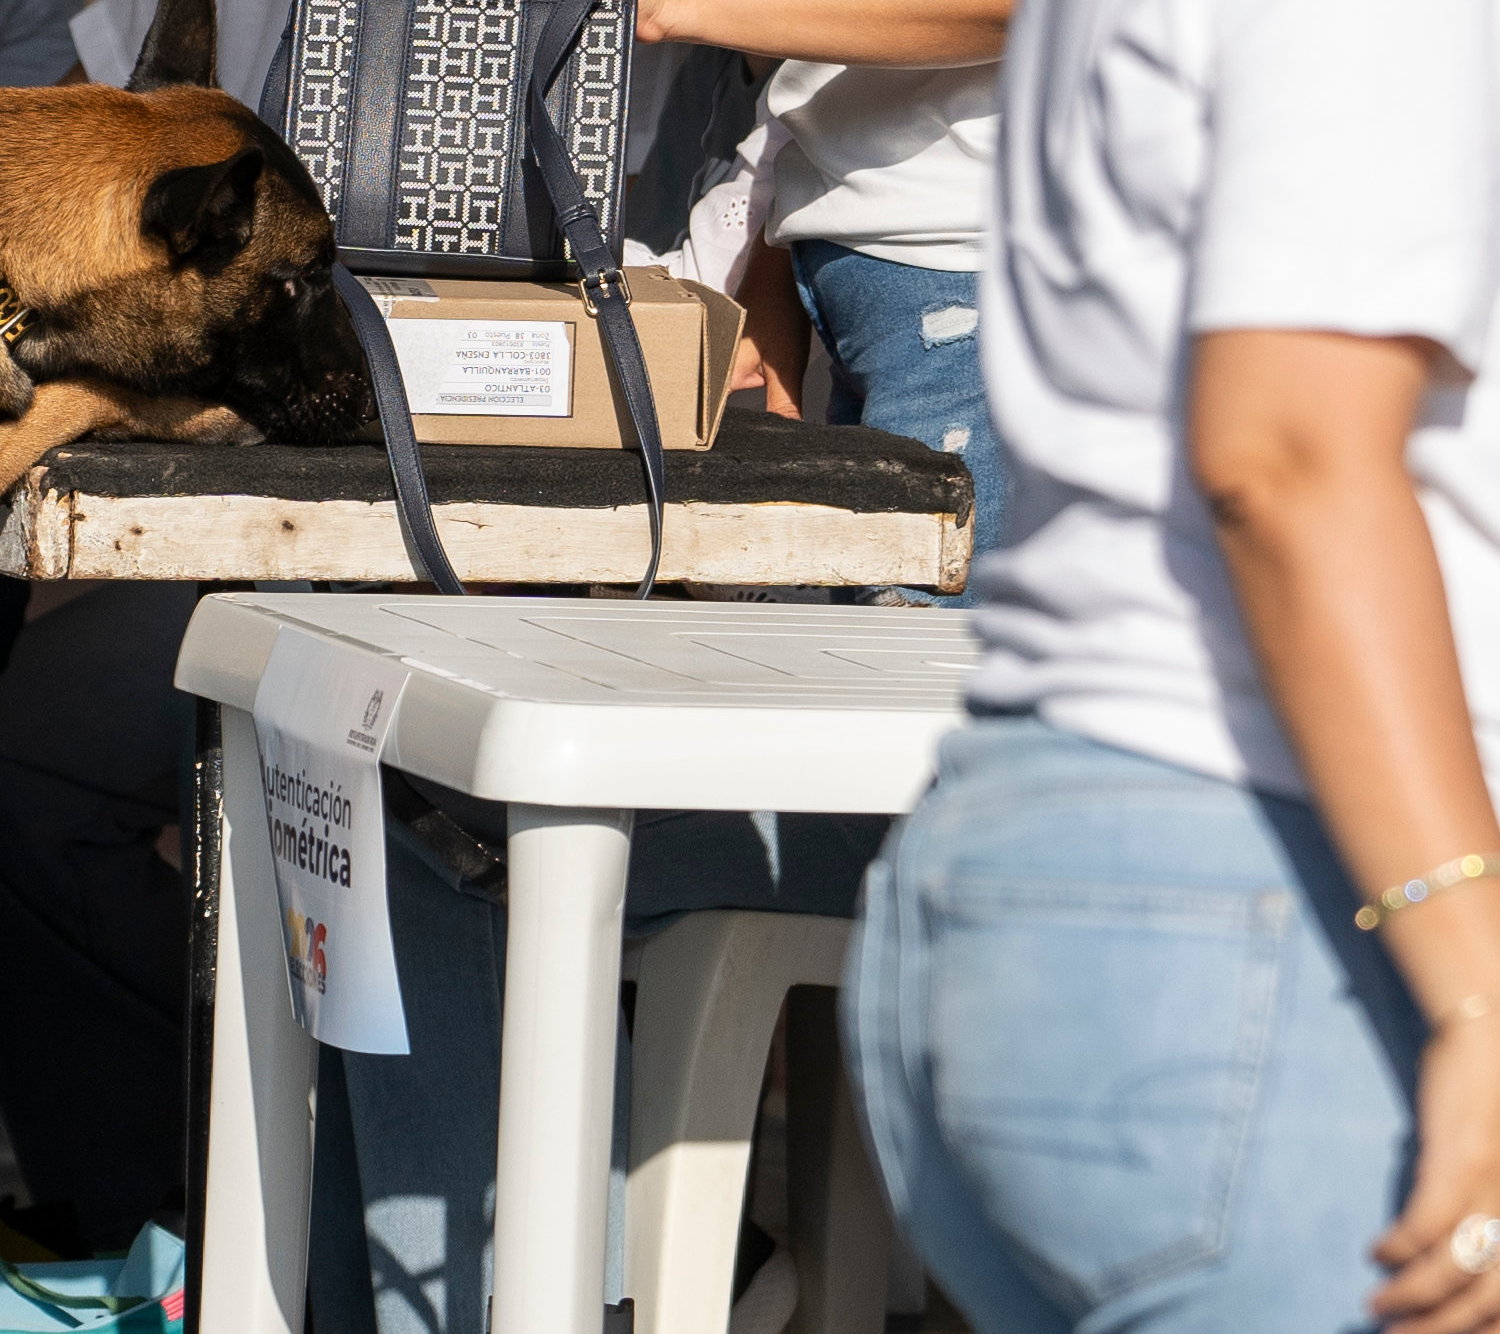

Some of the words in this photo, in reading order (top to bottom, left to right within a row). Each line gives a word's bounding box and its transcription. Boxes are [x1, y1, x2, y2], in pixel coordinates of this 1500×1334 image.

[456, 351, 489, 359] ENSEÑA
[463, 366, 551, 375] 001-BARRANQUILLA
[485, 385, 550, 393] 03-ATLANTICO
